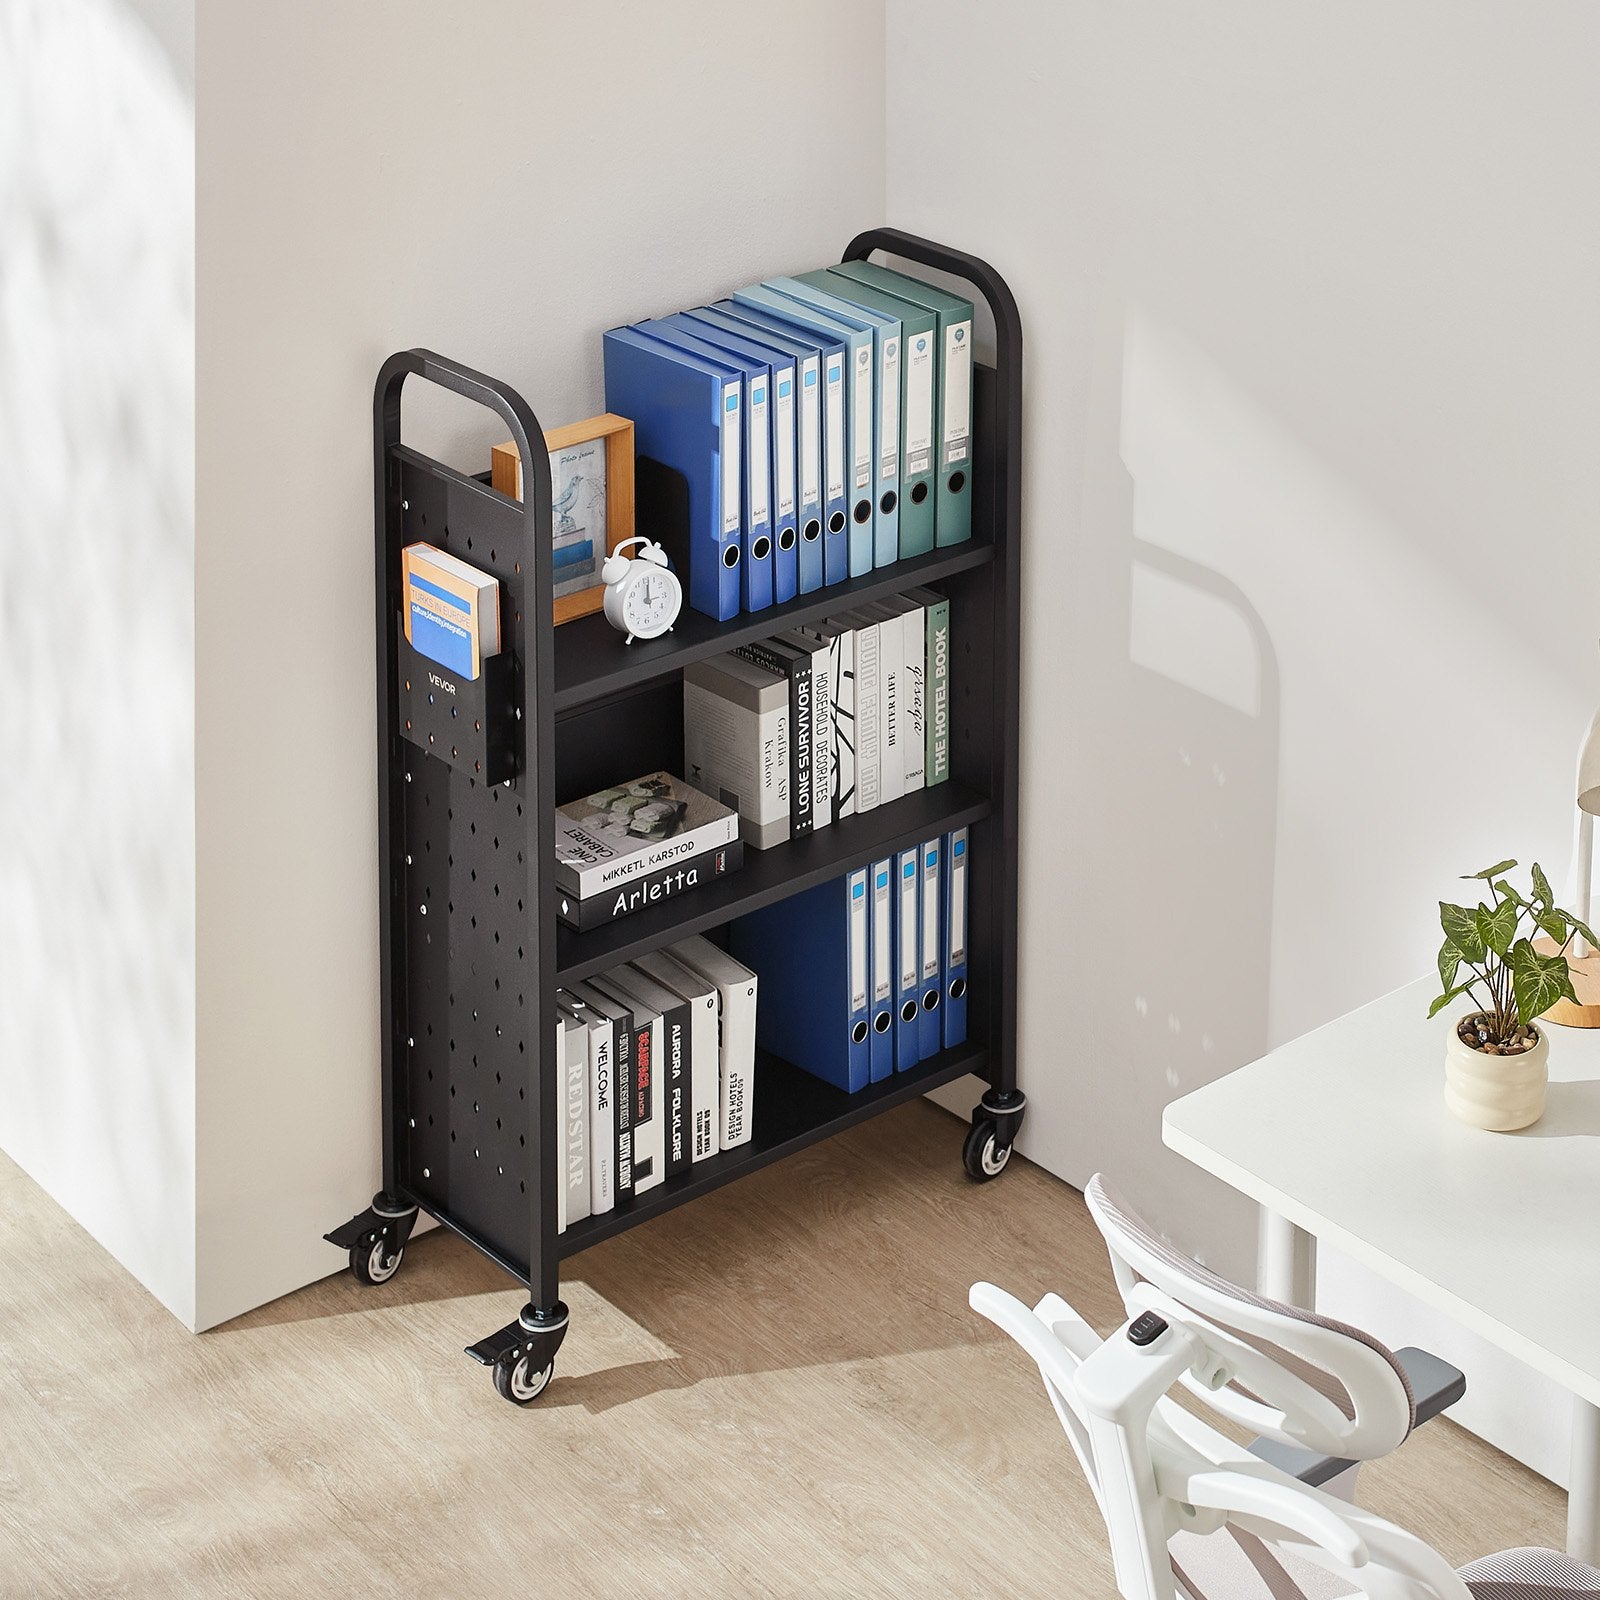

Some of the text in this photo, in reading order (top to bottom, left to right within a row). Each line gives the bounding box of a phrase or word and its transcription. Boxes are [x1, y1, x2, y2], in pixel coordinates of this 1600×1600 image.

[411, 589, 433, 608] TURKS
[442, 605, 471, 628] EUROPE
[934, 627, 947, 679] BOOK
[428, 672, 456, 696] VEVOR
[888, 671, 896, 747] BETTER LIFE
[934, 680, 946, 738] HOTEL
[777, 717, 787, 767] Grafika
[798, 681, 811, 815] LONE SURVIVOR
[815, 671, 828, 804] HOUSEHOLD DECORATES
[934, 739, 946, 777] THE
[764, 739, 774, 788] Krakow
[563, 828, 614, 858] CABARET
[602, 859, 645, 883] MIKKETL
[649, 841, 695, 865] KARSTOD
[612, 869, 698, 916] Arletta
[598, 1041, 608, 1111] WELCOME
[638, 1031, 650, 1090] SCARFACE
[671, 1024, 682, 1162] AURORA FOLKLORE
[728, 1072, 738, 1140] DESIGN HOTELS
[735, 1114, 743, 1138] YEAR
